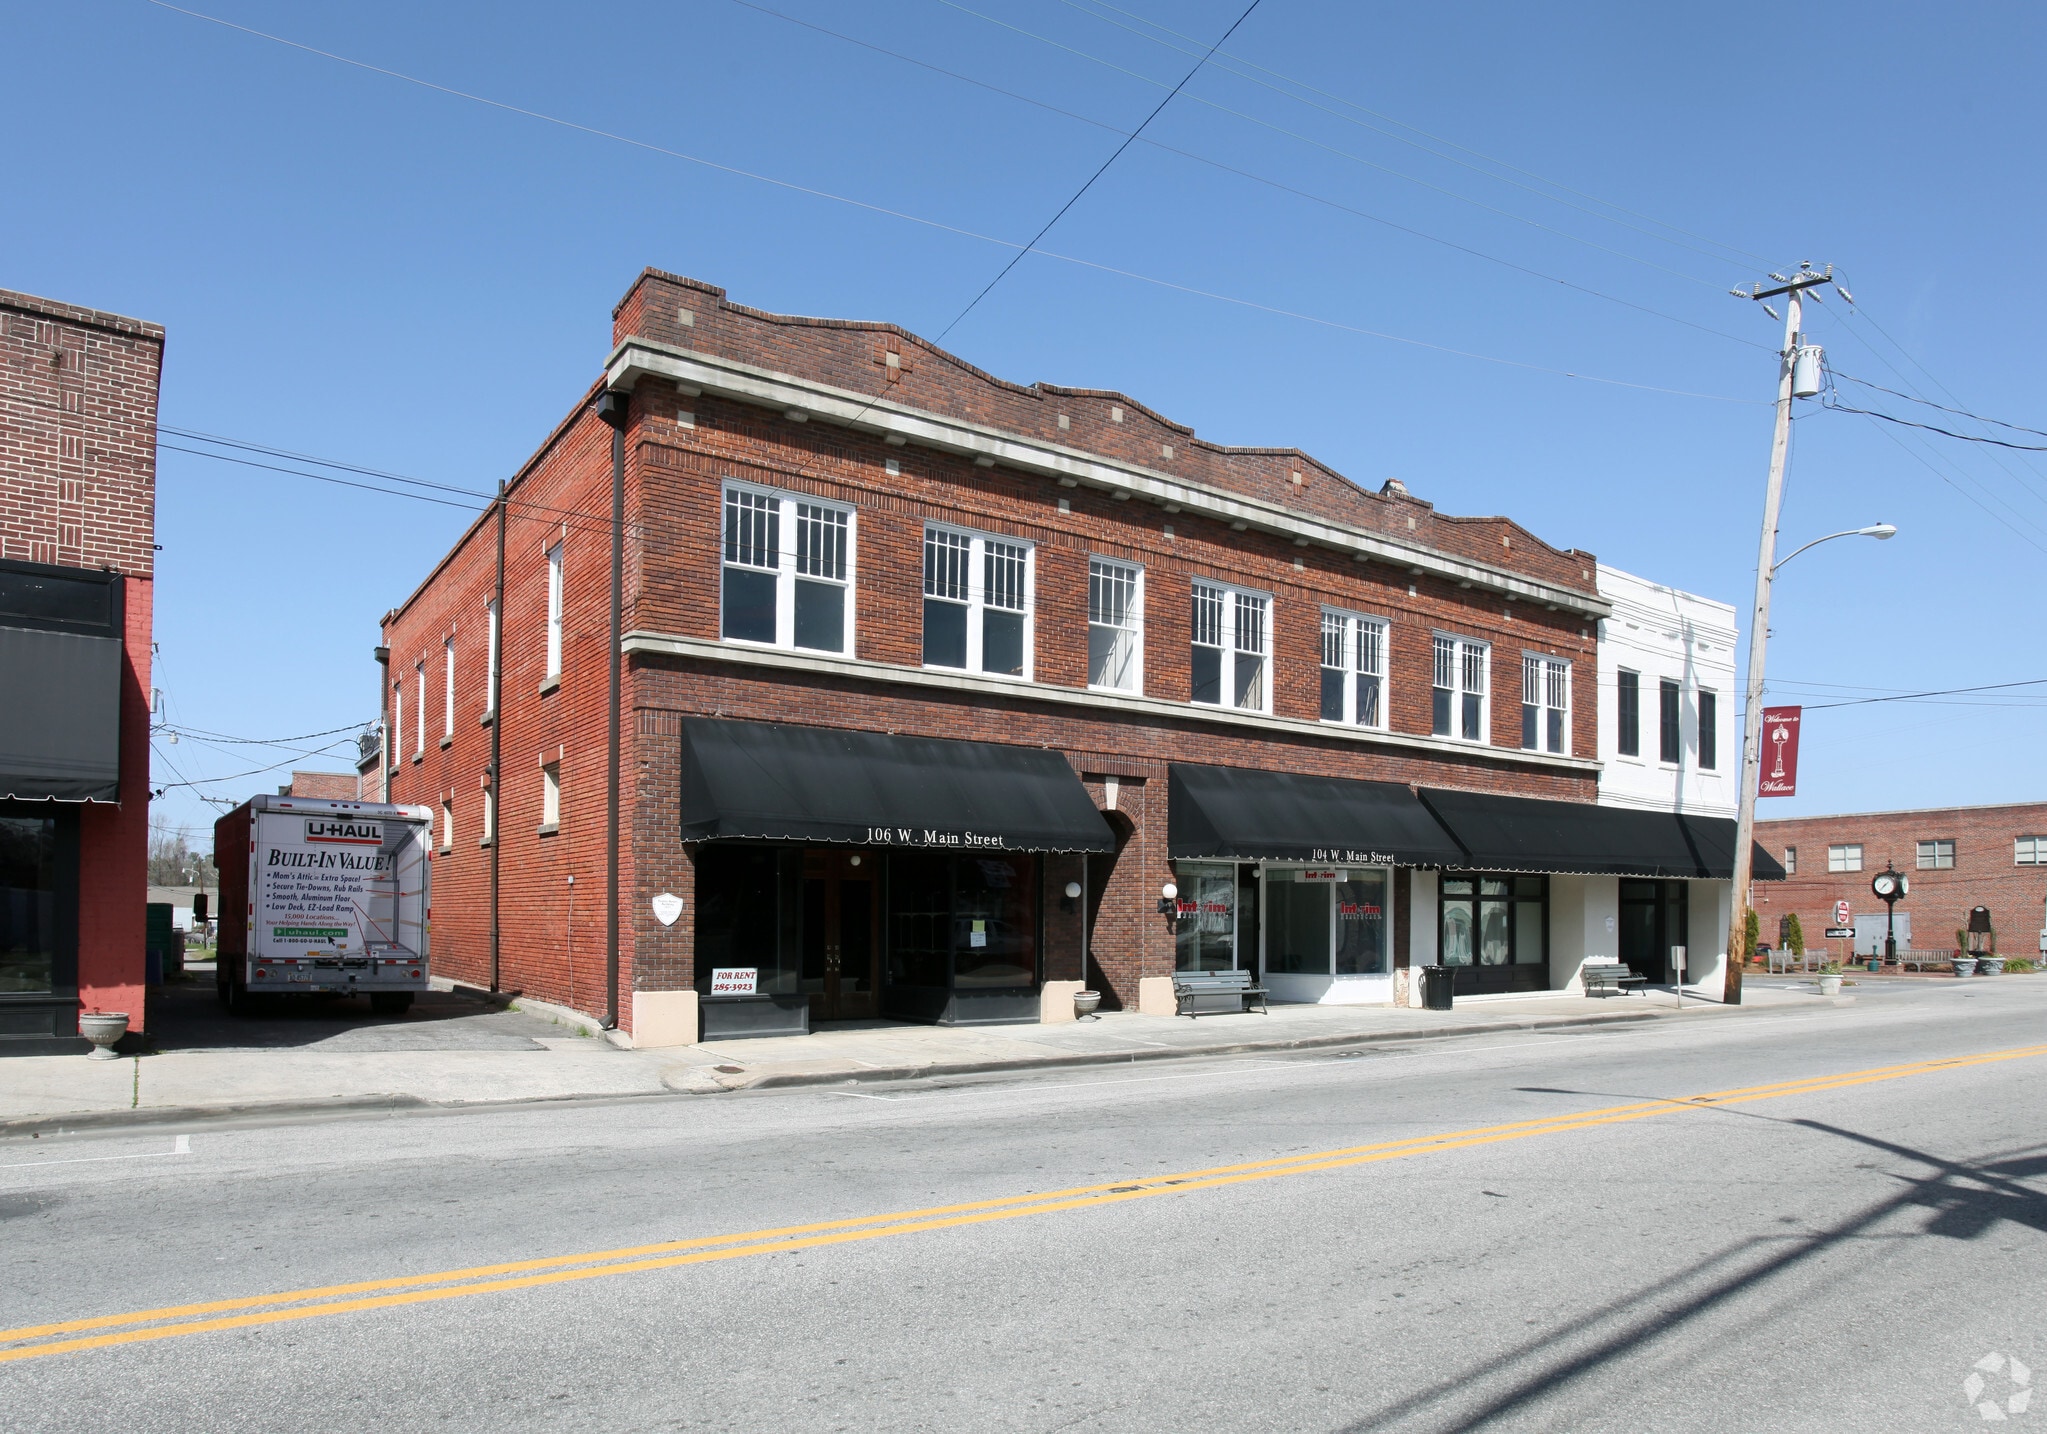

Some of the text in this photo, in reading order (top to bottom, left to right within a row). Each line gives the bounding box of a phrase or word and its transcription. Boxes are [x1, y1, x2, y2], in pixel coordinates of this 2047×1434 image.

[1764, 713, 1792, 723] Welcome
[1760, 780, 1794, 792] Wallace
[308, 822, 381, 838] U-HAUL
[868, 828, 1004, 846] 106 W. Main Street
[1312, 848, 1394, 862] 104 W. Main Street
[339, 852, 392, 871] VALUE!
[272, 872, 295, 880] Mom's
[340, 874, 360, 884] Space!
[296, 883, 331, 892] Tie-Downs,
[272, 892, 298, 901] Smooth,
[301, 894, 333, 902] Aluminum
[288, 903, 305, 912] Deck,
[336, 905, 354, 914] Ramp
[713, 983, 752, 991] 285-3923
